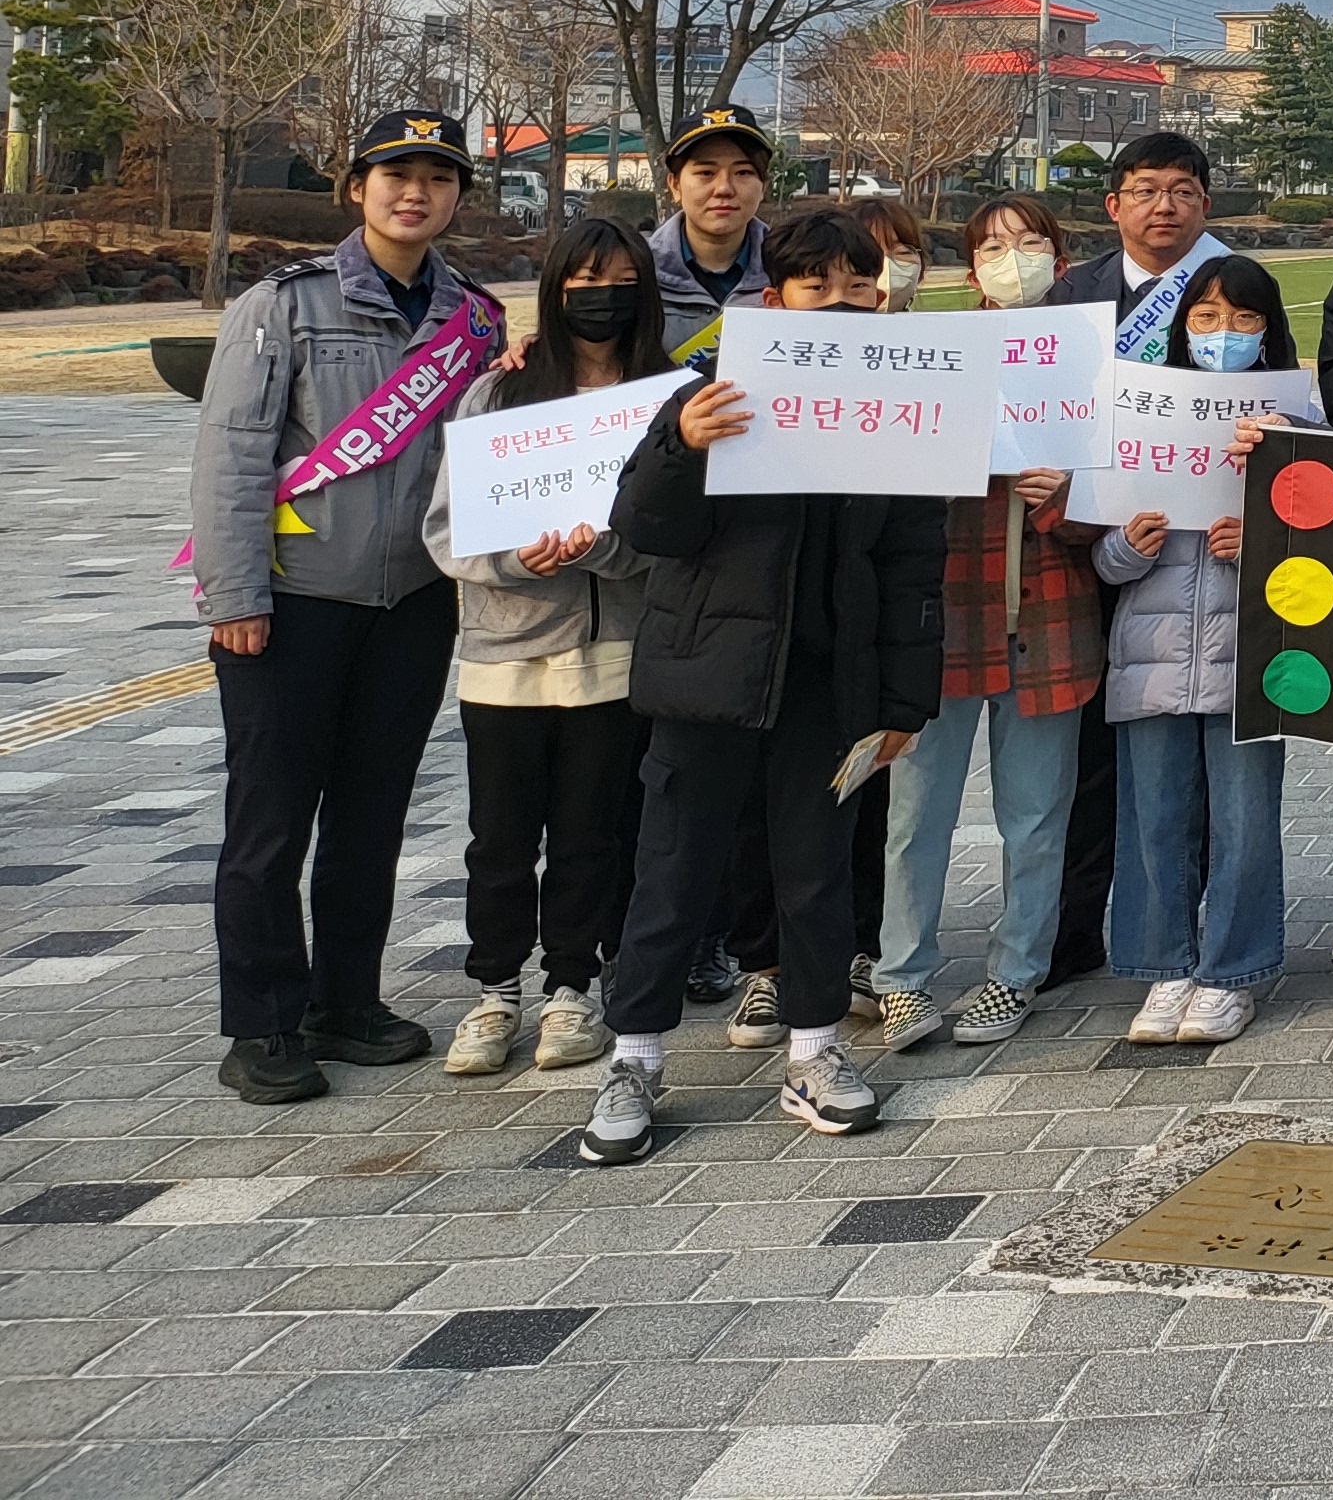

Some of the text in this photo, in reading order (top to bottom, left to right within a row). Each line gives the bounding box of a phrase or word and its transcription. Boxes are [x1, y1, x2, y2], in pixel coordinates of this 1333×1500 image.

[762, 340, 964, 371] 스쿨존 횡단보도
[1001, 334, 1059, 365] 교앞
[771, 395, 942, 435] 일단정지!
[1001, 397, 1096, 423] No! No!
[1114, 388, 1176, 417] 스쿨존
[489, 423, 577, 459] 횡단보도
[487, 468, 573, 506] 우리생명
